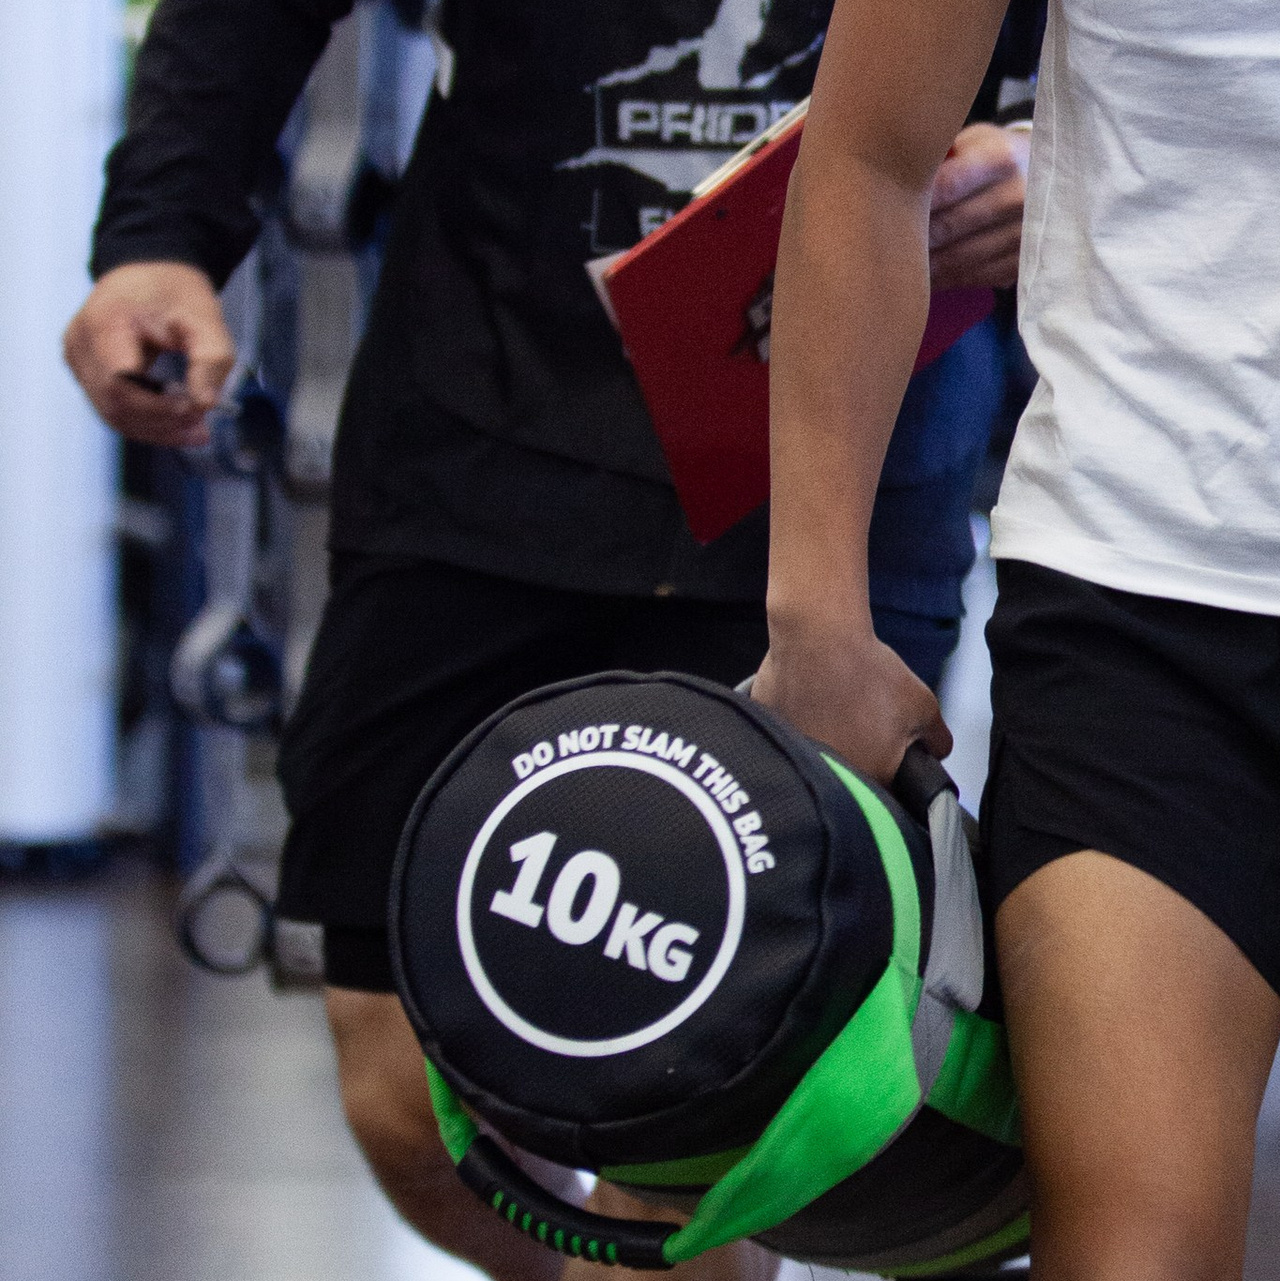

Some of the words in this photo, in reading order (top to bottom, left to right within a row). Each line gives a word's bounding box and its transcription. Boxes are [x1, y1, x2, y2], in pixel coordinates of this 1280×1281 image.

[512, 741, 554, 779] DO
[558, 724, 620, 757] NOT
[621, 725, 698, 768] SLAM
[692, 753, 750, 814] THIS
[733, 811, 776, 874] BAG
